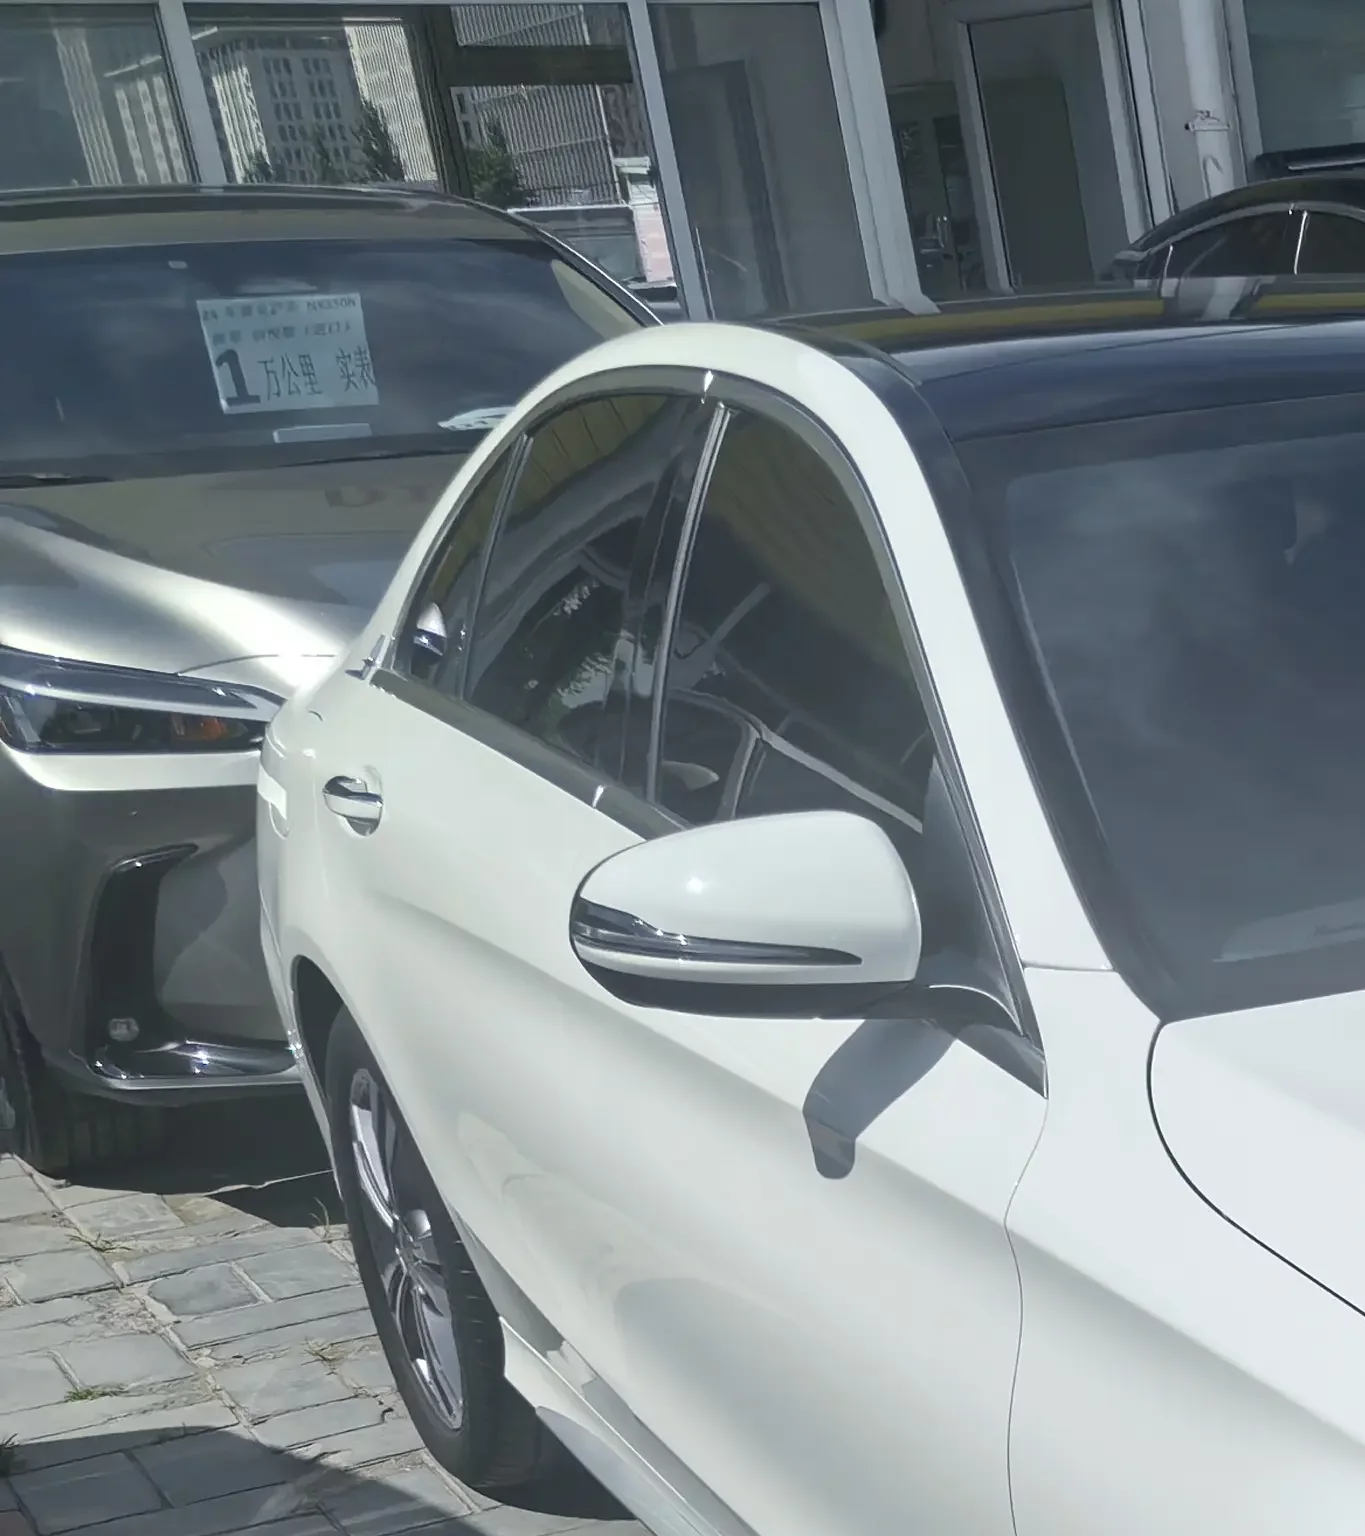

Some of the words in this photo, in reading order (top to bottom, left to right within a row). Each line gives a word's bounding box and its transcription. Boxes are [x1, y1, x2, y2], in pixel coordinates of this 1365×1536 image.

[215, 349, 262, 406] 1
[257, 352, 324, 401] 万公里
[335, 344, 377, 392] 实表
